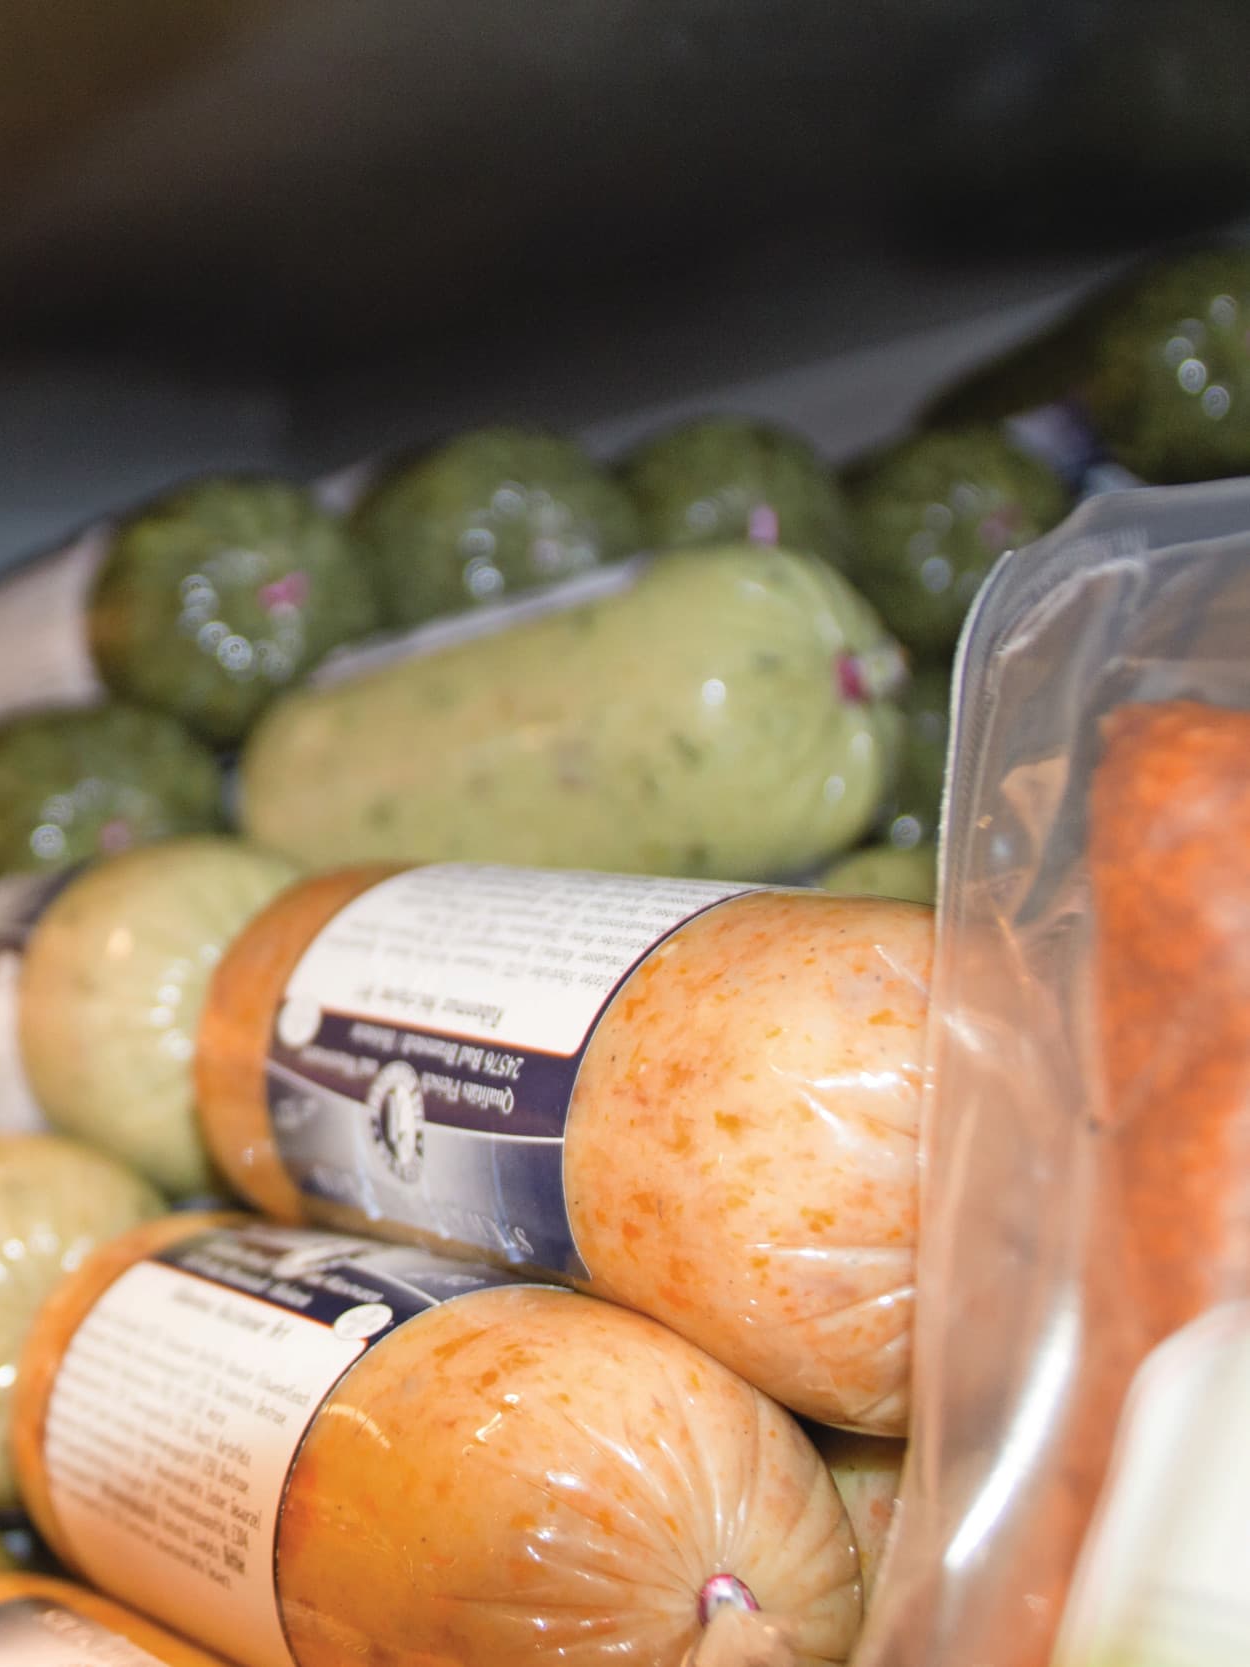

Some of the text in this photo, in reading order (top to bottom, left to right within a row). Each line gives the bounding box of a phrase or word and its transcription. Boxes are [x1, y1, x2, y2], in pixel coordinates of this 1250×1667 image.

[458, 1045, 485, 1072] Bad
[485, 1051, 525, 1080] 24576
[462, 1081, 514, 1114] Qualitäts
